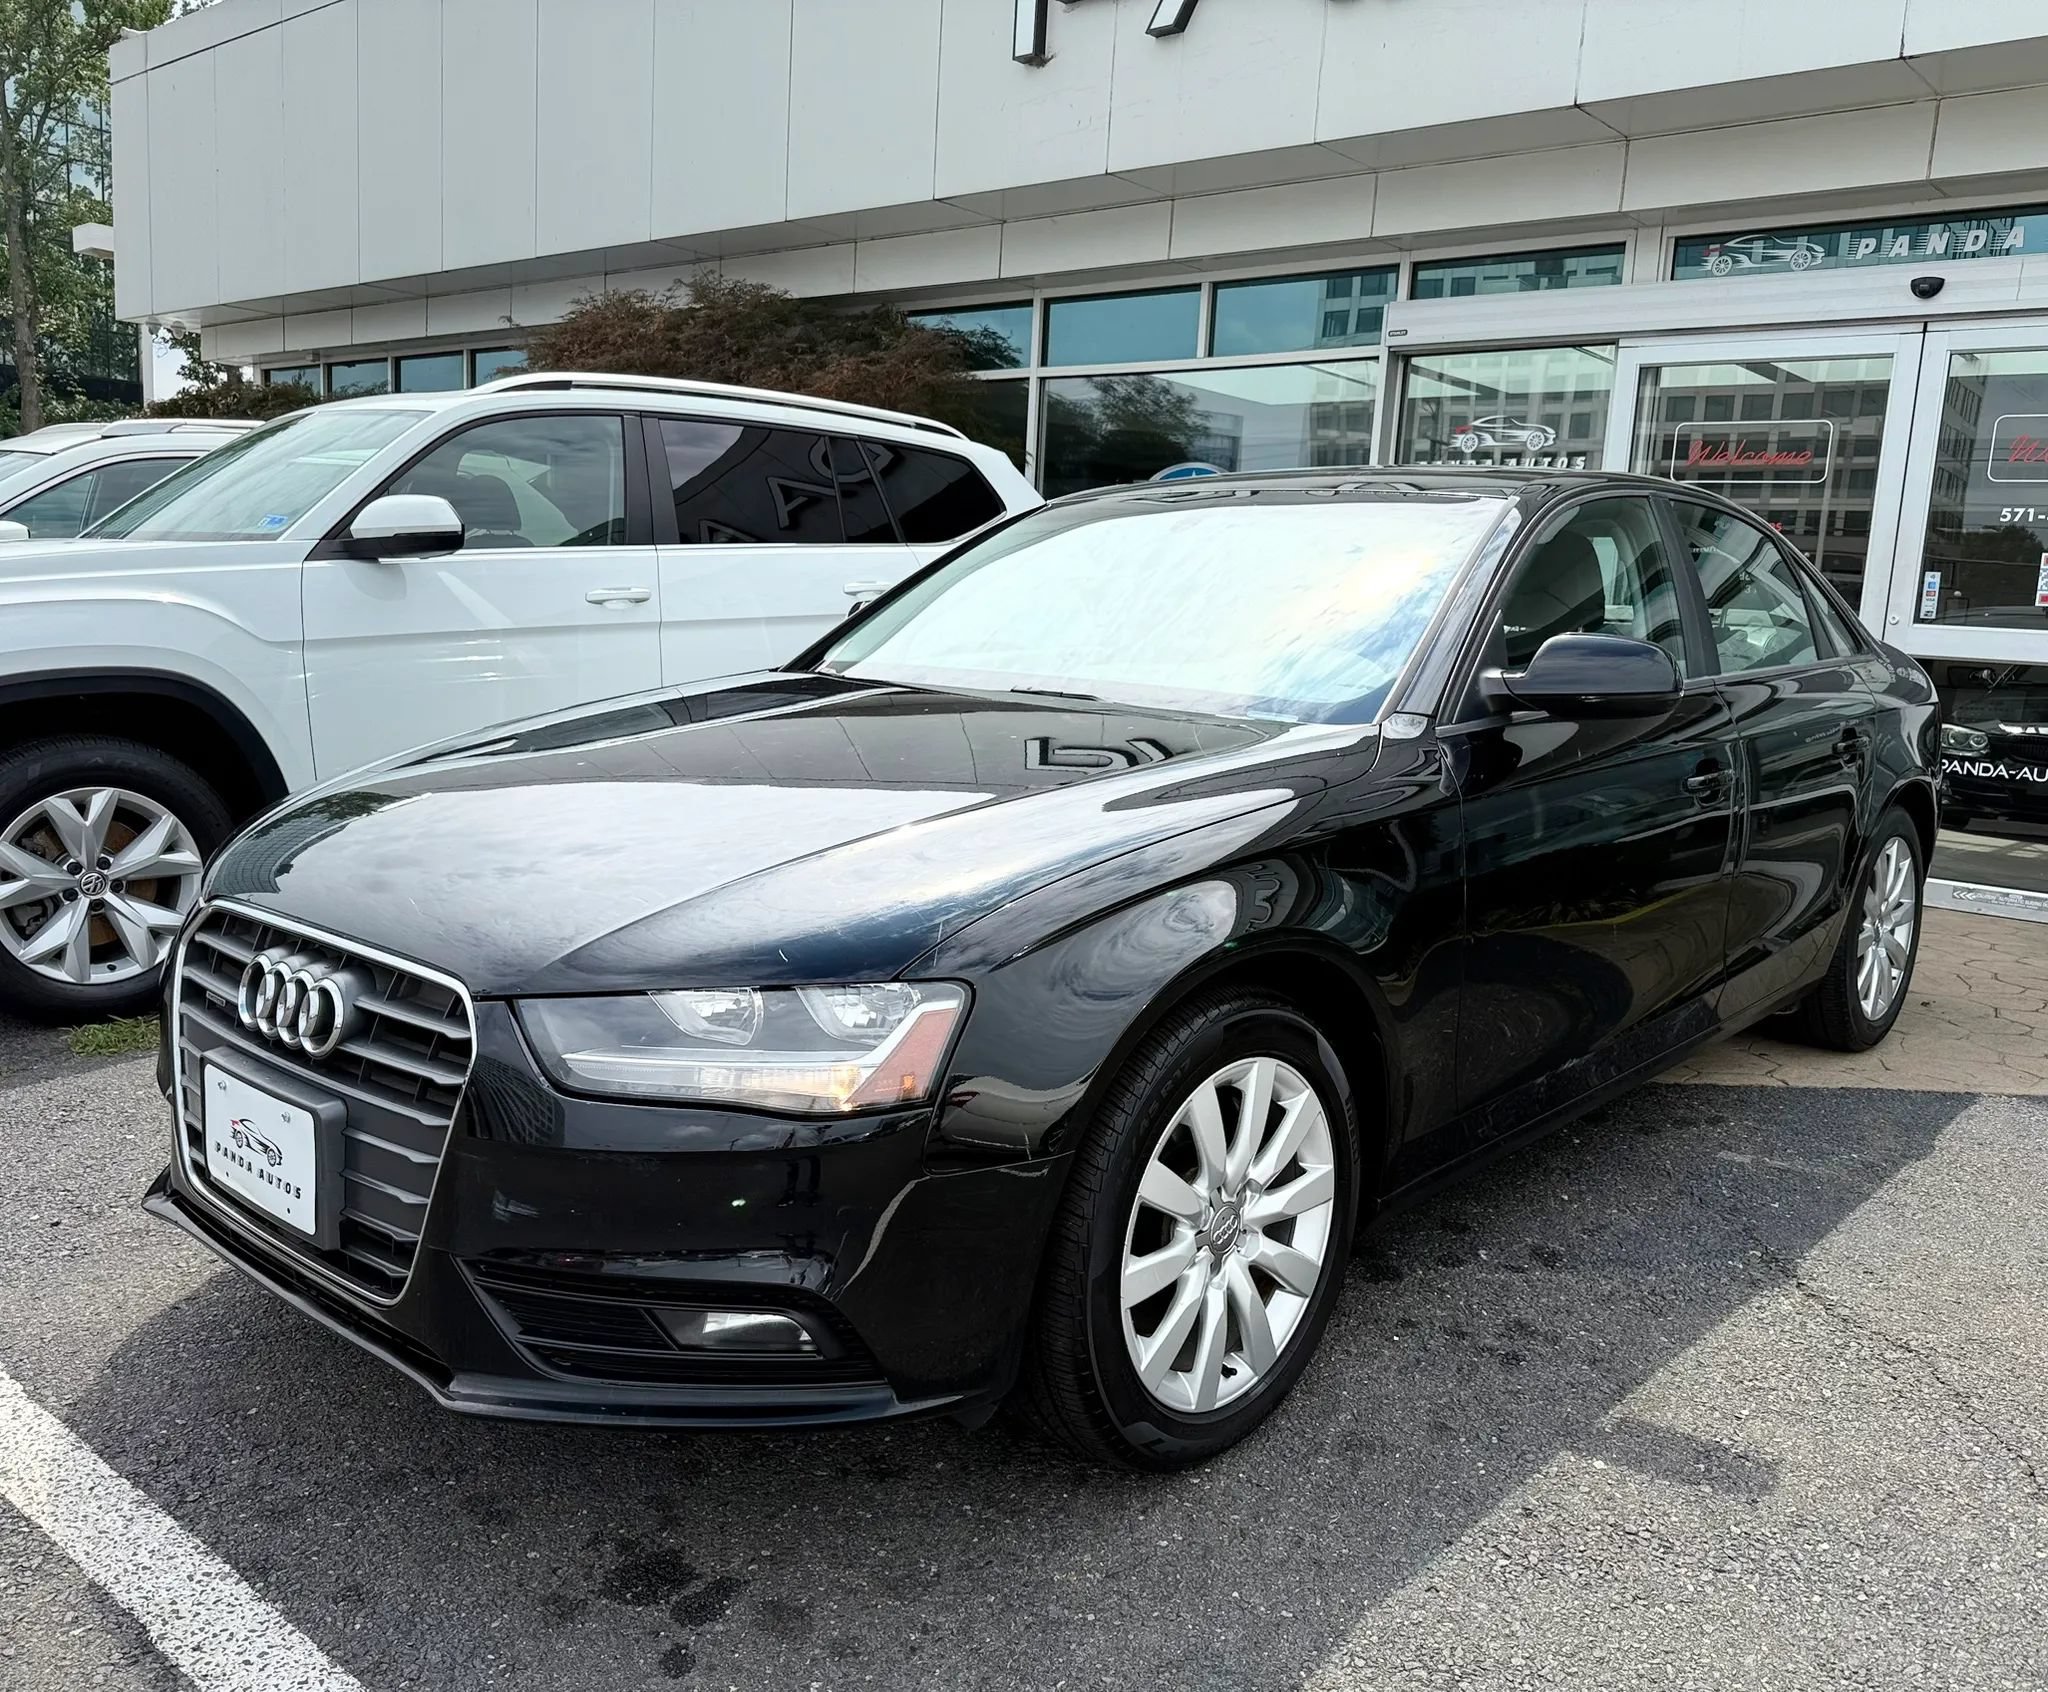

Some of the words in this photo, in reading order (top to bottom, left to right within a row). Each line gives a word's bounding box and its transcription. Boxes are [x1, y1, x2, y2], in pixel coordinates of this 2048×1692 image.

[1850, 225, 2026, 261] PANDA
[1686, 438, 1815, 467] Welcome
[1999, 508, 2048, 522] 571-
[214, 1140, 253, 1173] PANDA
[257, 1167, 303, 1200] AUTOS
